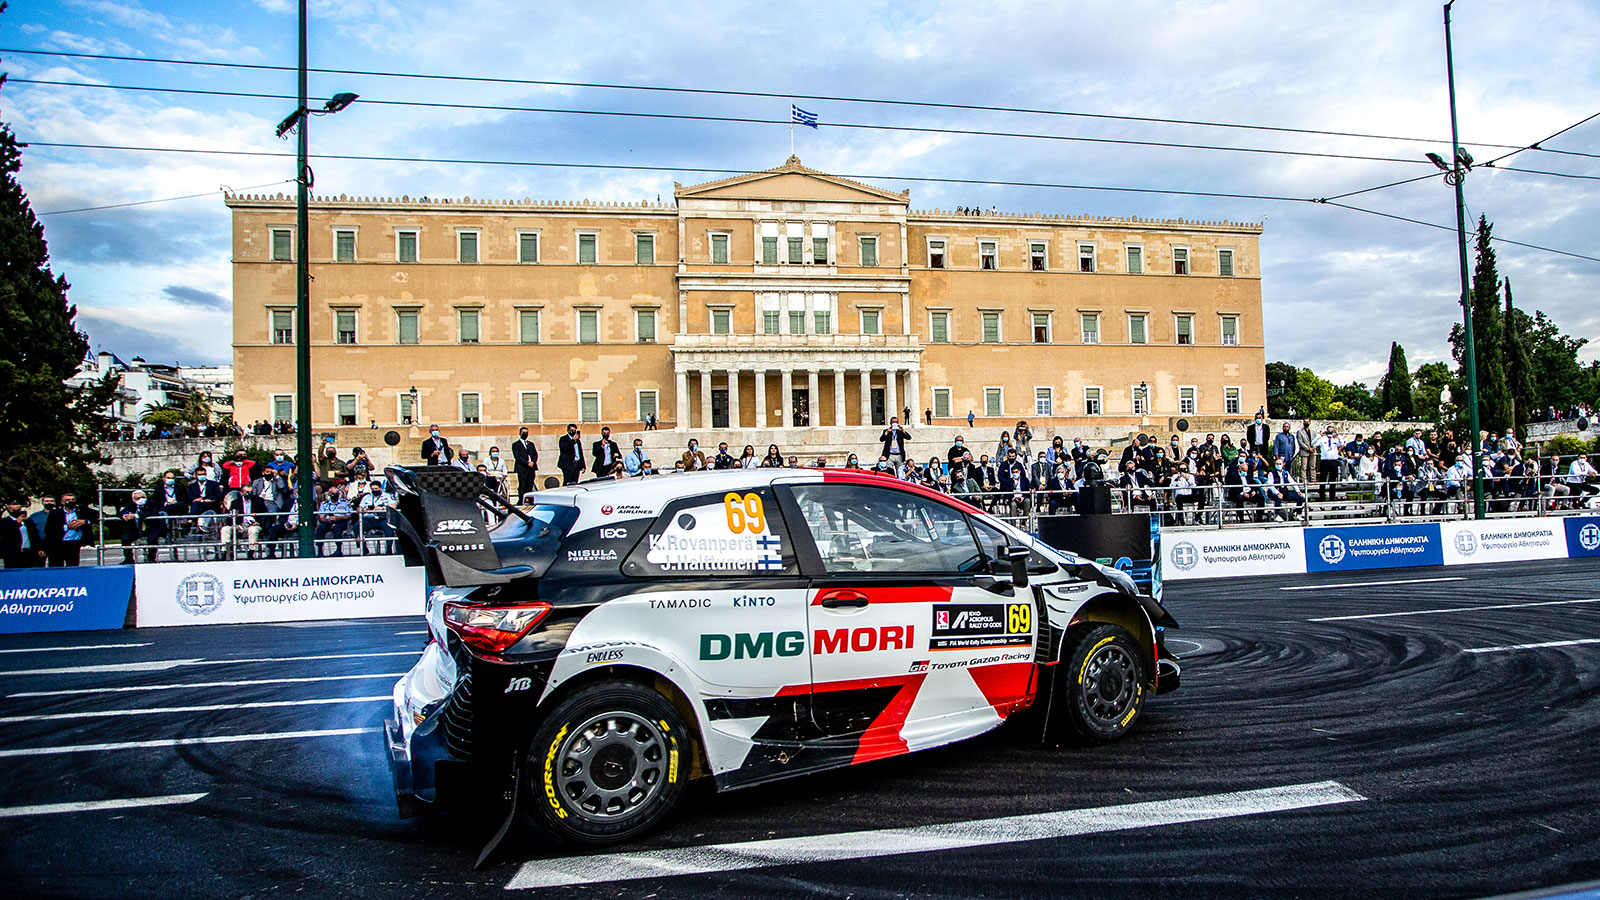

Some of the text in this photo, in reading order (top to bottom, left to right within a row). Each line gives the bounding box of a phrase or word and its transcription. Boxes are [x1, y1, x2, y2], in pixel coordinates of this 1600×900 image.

[724, 492, 765, 534] 69
[437, 520, 478, 532] SWS
[1348, 536, 1429, 547] ΕΛΛΗΝΙΚΗ ΔΗΜΟΚΡΑΤΙΑ
[1481, 530, 1554, 540] ΕΛΛΗΝΙΚΗ ΔΗΜΟΚΡΑΤΙΑ
[441, 543, 485, 551] PONSSE
[567, 549, 617, 557] NISULA
[1203, 542, 1290, 553] ΕΛΛΗΝΙΚΗ ΔΗΜΟΚΡΑΤΙΑ
[233, 574, 384, 589] ΕΛΛΗΝΙΚΗ ΔΗΜΟΚΡΑΤΙΑ
[234, 588, 375, 605] Υφυπουργείο Αθλητισμού
[0, 601, 74, 615] Αθλητισμού
[649, 599, 712, 609] TAMADIC
[1008, 604, 1031, 633] 69
[699, 625, 915, 660] DMG MORI
[586, 649, 625, 663] ENDLESS
[909, 652, 1031, 672] GR TOYOTA GAZOO Racing
